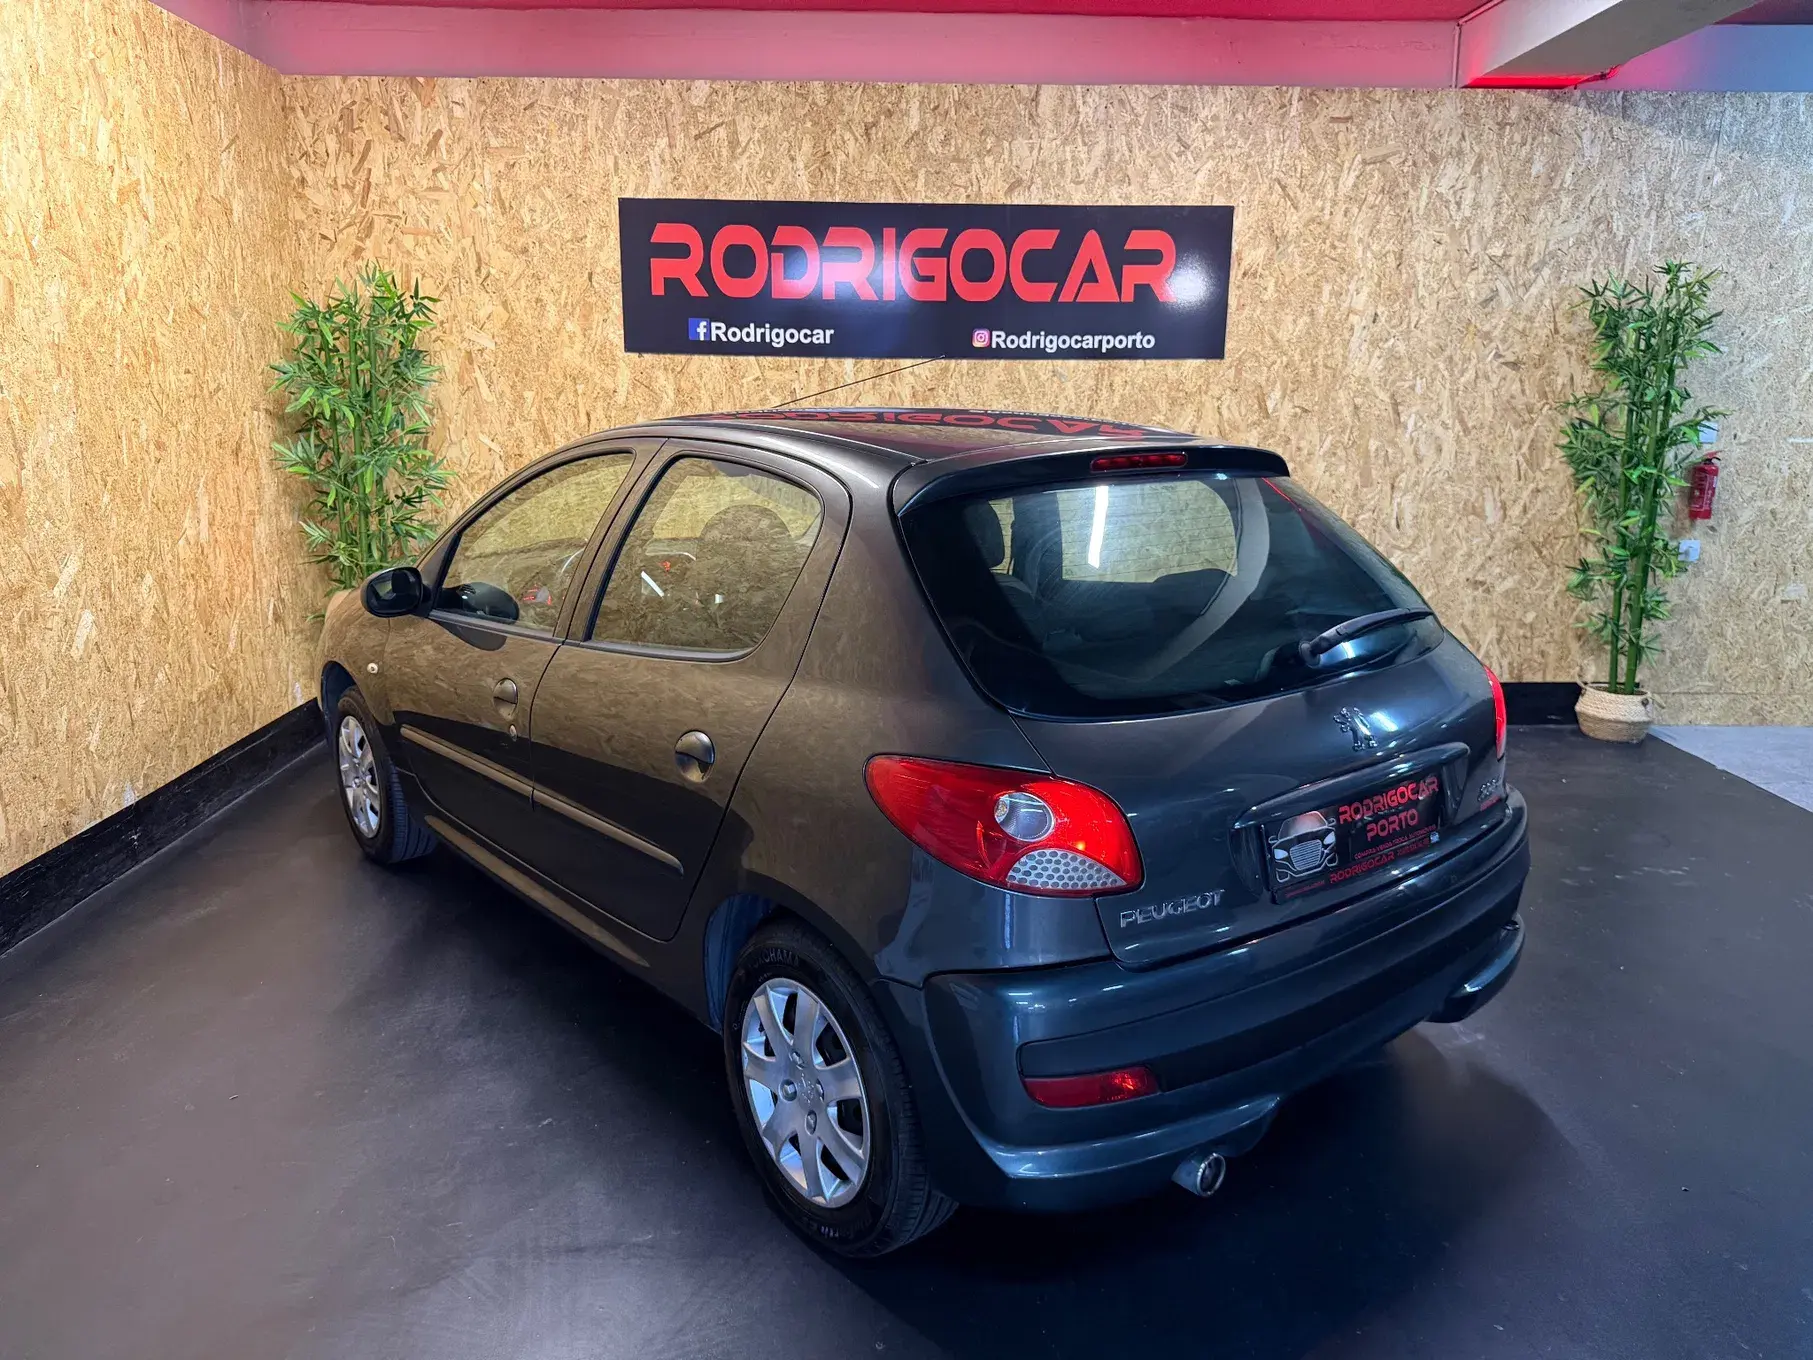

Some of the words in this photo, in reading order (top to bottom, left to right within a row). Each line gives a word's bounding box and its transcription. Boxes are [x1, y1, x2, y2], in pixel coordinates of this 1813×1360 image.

[650, 222, 1177, 303] RODRIGOCAR
[710, 321, 835, 348] Rodrigocar
[991, 330, 1156, 353] Rodrigocarporto
[1338, 776, 1439, 824] RODRIGOCAR
[1366, 807, 1419, 842] PORTO
[1120, 889, 1225, 928] PEUGEOT
